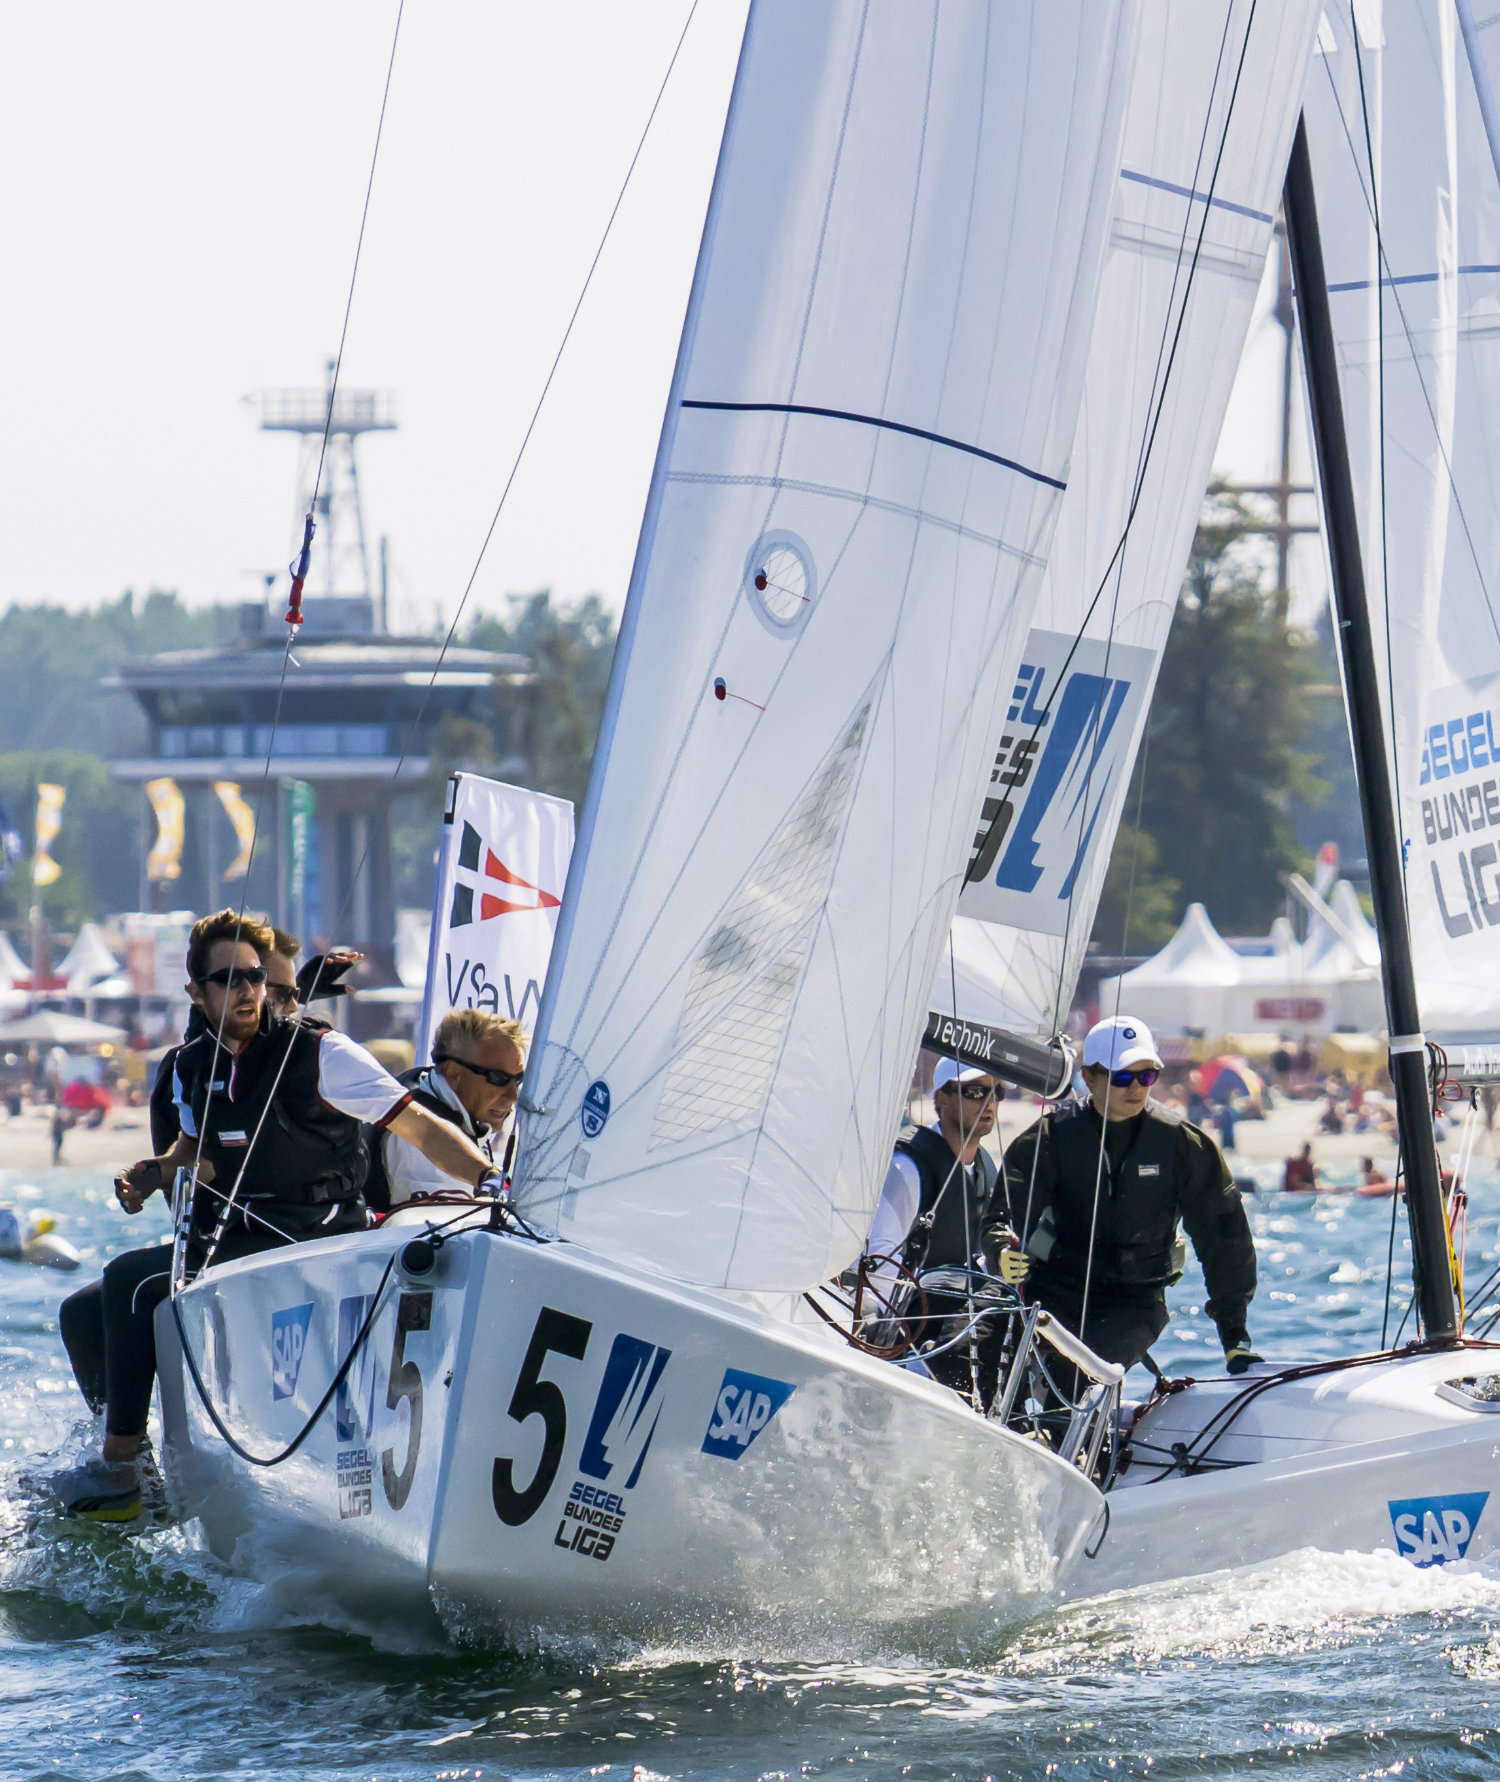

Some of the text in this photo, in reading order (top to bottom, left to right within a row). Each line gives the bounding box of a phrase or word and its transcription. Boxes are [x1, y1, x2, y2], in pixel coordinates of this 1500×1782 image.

[272, 1322, 303, 1379] SAP
[382, 1291, 434, 1511] 5
[492, 1306, 593, 1527] 5
[708, 1384, 772, 1446] SAP
[337, 1449, 373, 1471] SEGEL
[563, 1501, 624, 1534] BUNDES
[569, 1481, 627, 1517] SEGEL
[1395, 1509, 1471, 1564] SAP
